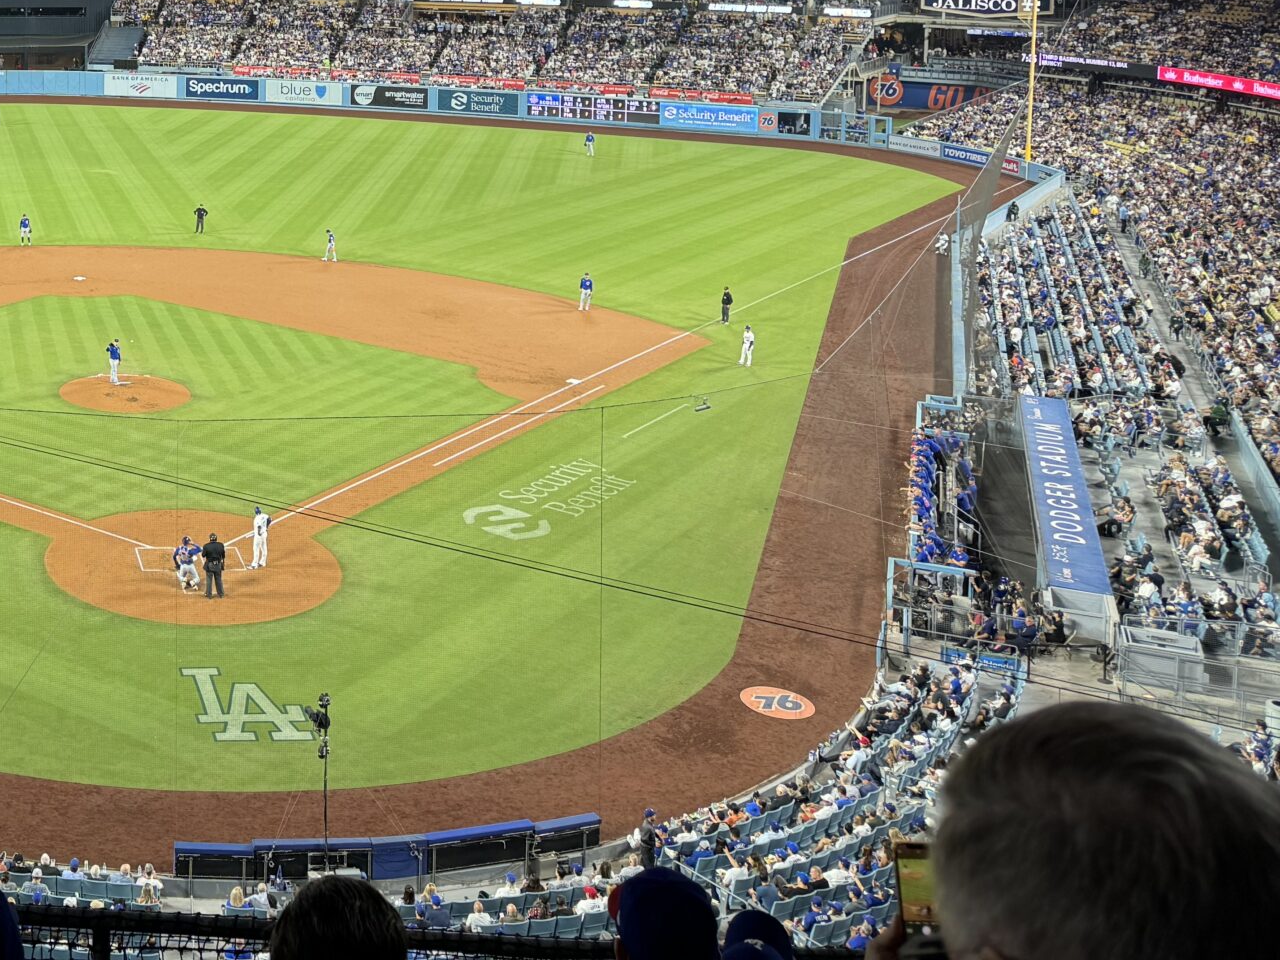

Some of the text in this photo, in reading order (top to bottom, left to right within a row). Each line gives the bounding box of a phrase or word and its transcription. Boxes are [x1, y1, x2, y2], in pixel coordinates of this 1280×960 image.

[189, 80, 248, 94] Spectrum
[1183, 71, 1223, 87] Budweiser
[280, 82, 312, 96] blue
[385, 91, 424, 99] smartwater
[875, 80, 899, 99] 76
[471, 93, 504, 107] Security
[927, 85, 966, 111] GO
[471, 103, 500, 112] Benefit
[678, 109, 751, 122] Security Benefit
[761, 116, 774, 126] 76
[944, 148, 988, 163] TOYO TIRES
[1033, 422, 1072, 477] STADIUM
[499, 458, 607, 504] Security
[542, 472, 637, 518] Benefit
[1043, 482, 1087, 545] DODGER
[179, 666, 317, 742] LA
[752, 693, 804, 713] 76
